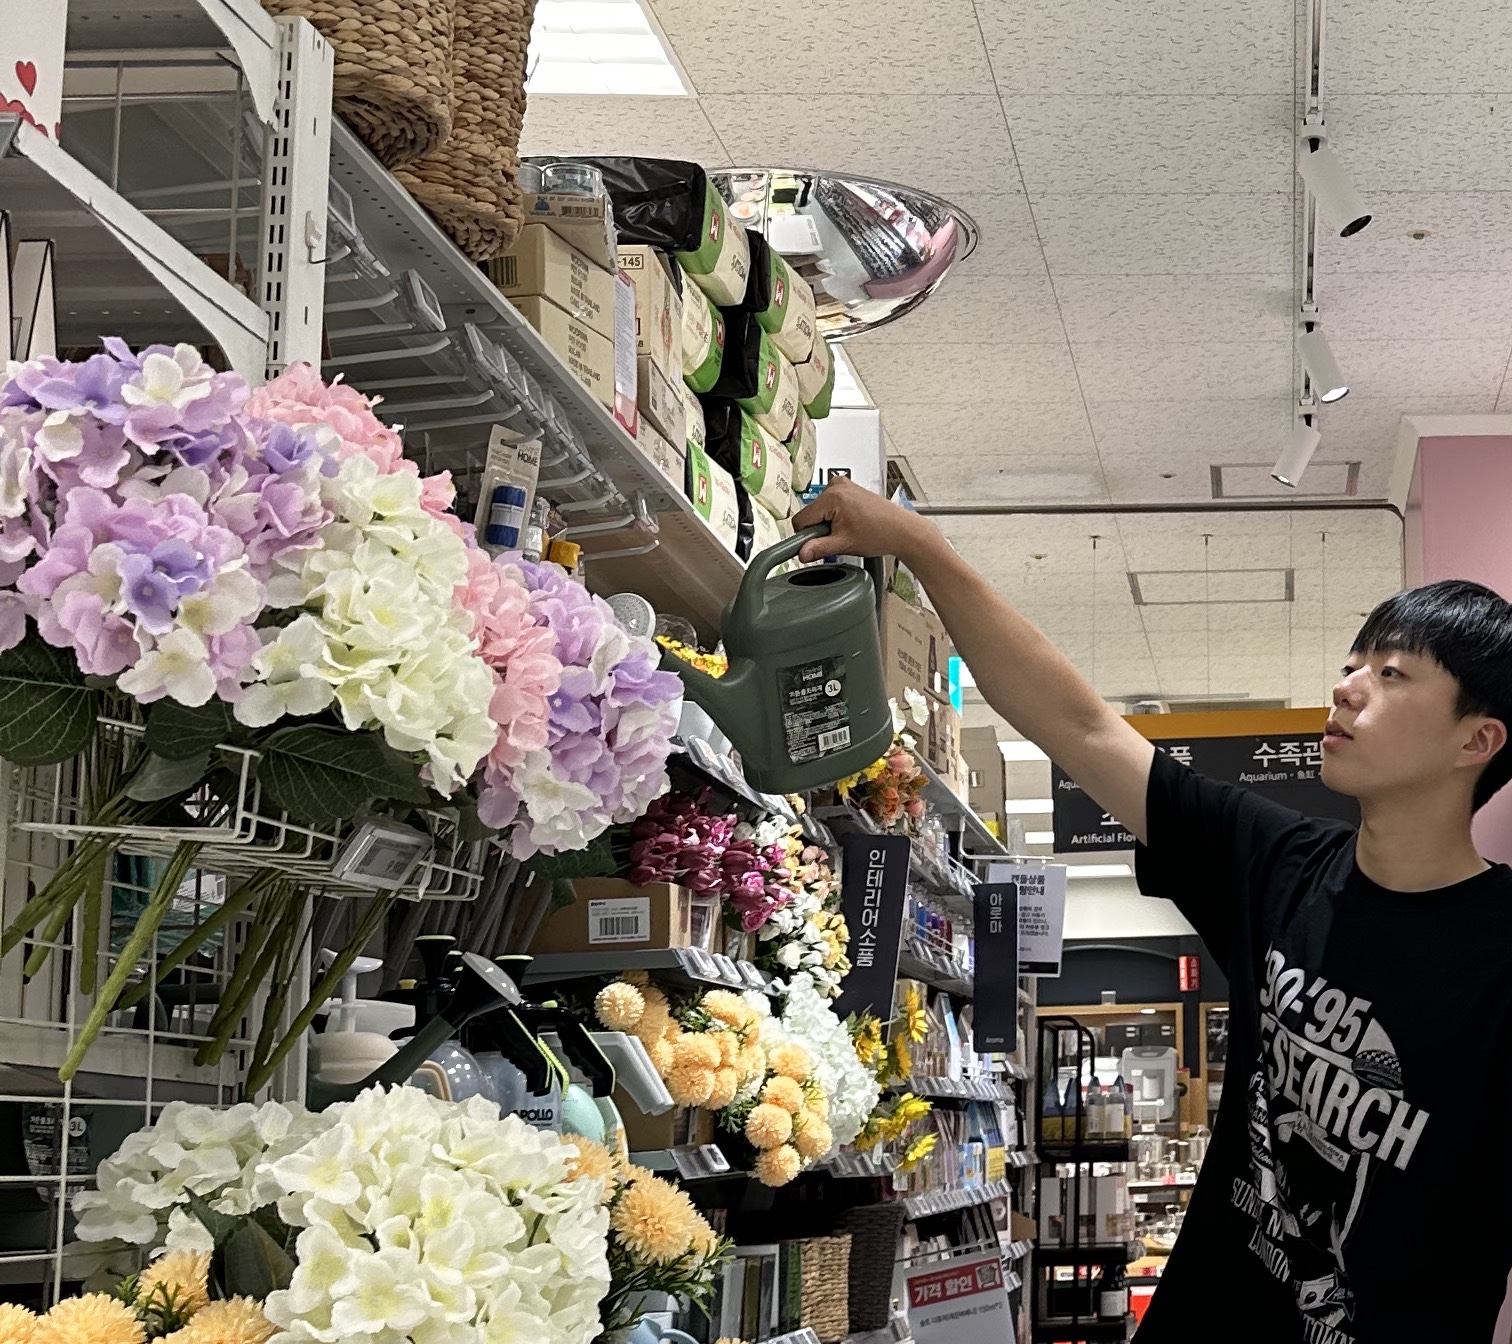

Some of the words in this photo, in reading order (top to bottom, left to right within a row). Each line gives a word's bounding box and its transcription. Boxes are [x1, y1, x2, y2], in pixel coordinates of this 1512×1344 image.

[827, 683, 838, 692] 3L
[1239, 771, 1287, 783] Aquarium
[1071, 833, 1115, 844] Artificial
[856, 849, 887, 967] 인테리어소품
[989, 892, 1003, 933] 아로마
[70, 1121, 83, 1132] 3L
[1248, 1224, 1291, 1283] LONDON
[914, 1283, 942, 1304] 가격
[944, 1274, 973, 1296] 할인
